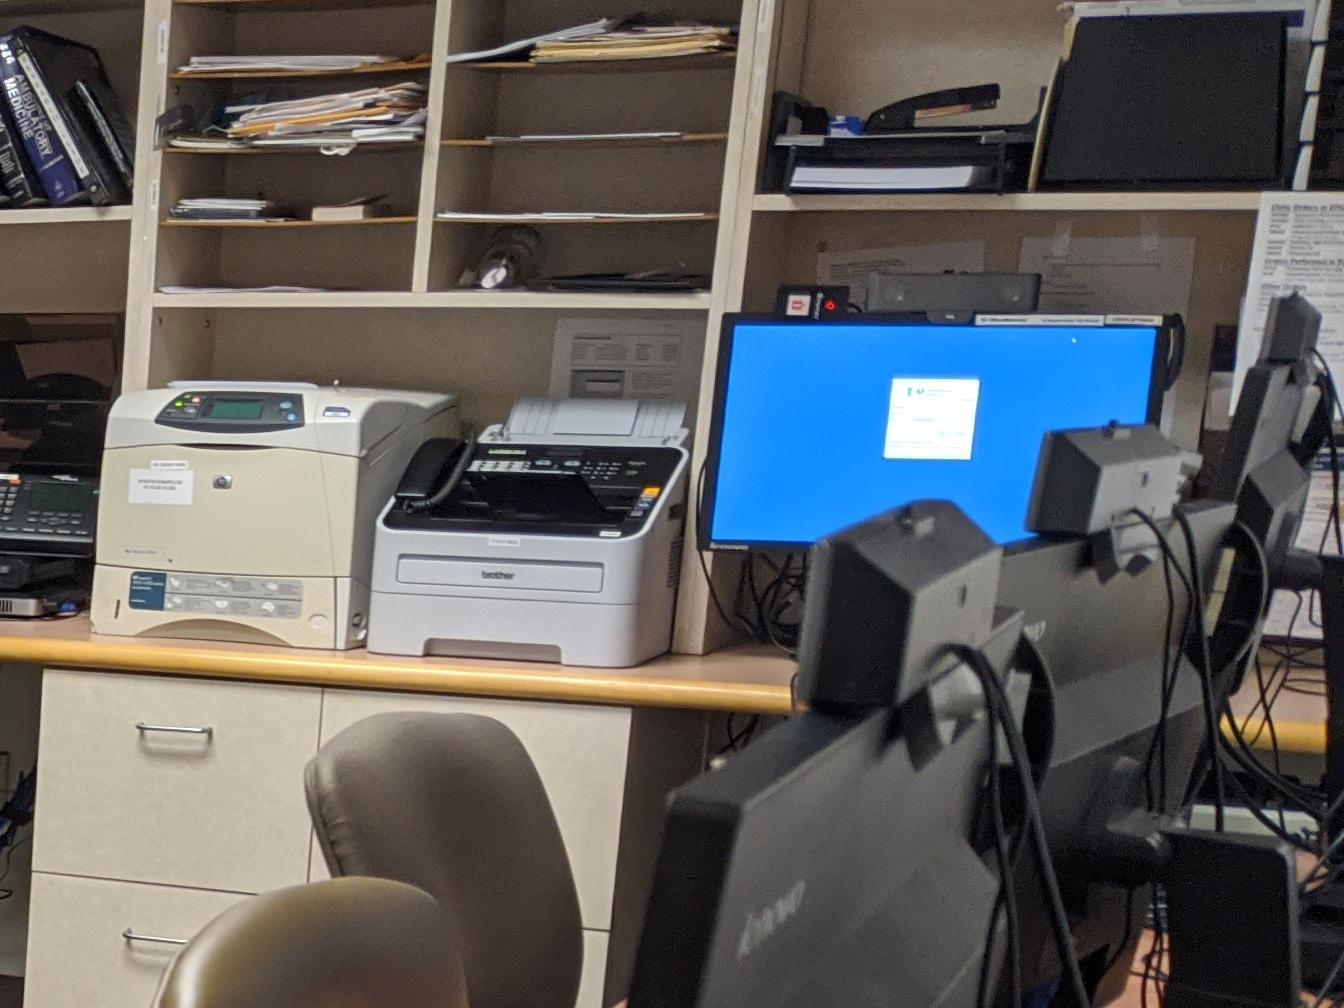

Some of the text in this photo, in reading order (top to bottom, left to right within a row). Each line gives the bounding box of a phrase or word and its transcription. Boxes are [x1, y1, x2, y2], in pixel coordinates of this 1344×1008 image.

[4, 77, 33, 140] MEDICINE
[13, 74, 53, 156] AMBULATORY
[481, 570, 515, 581] brother
